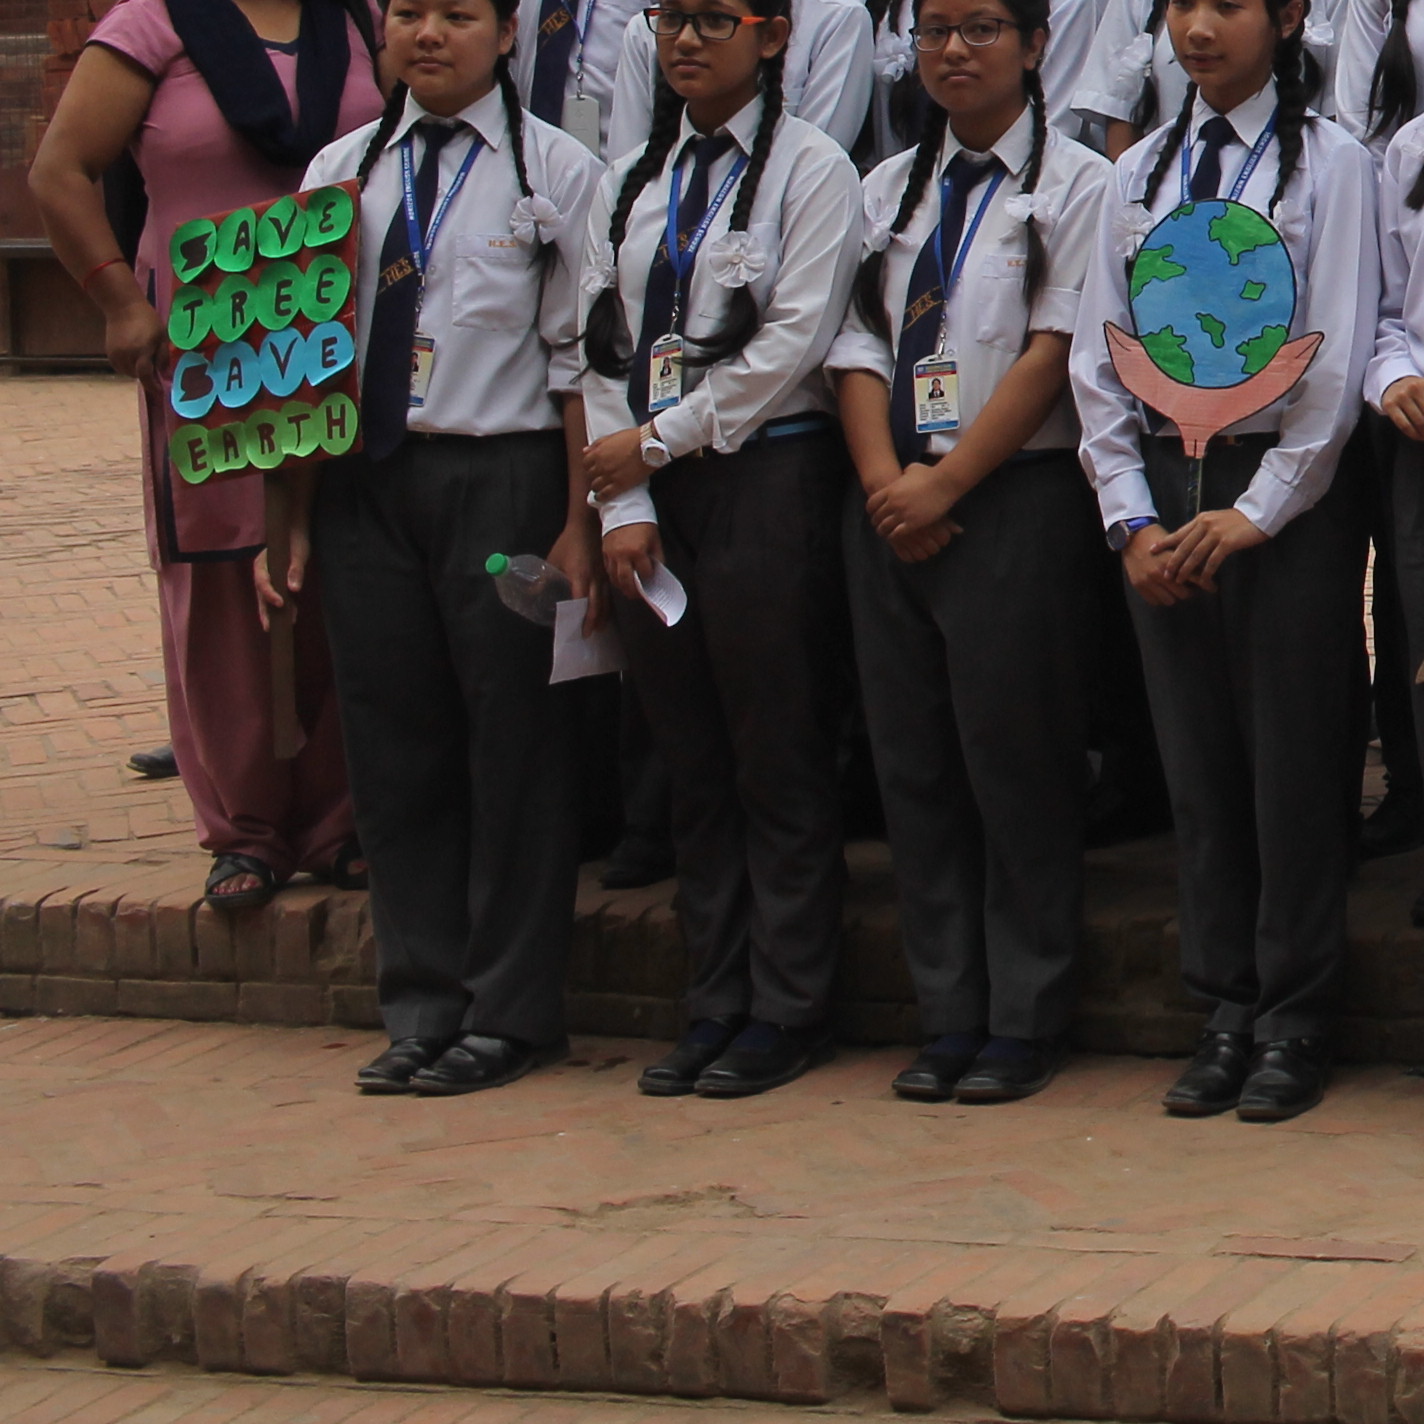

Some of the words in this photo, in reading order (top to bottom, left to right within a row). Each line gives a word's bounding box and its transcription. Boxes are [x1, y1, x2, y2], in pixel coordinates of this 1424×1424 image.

[180, 201, 336, 273] SAVE
[183, 267, 334, 339] TREE
[179, 337, 338, 403] SAVE
[187, 403, 346, 473] EARTH
